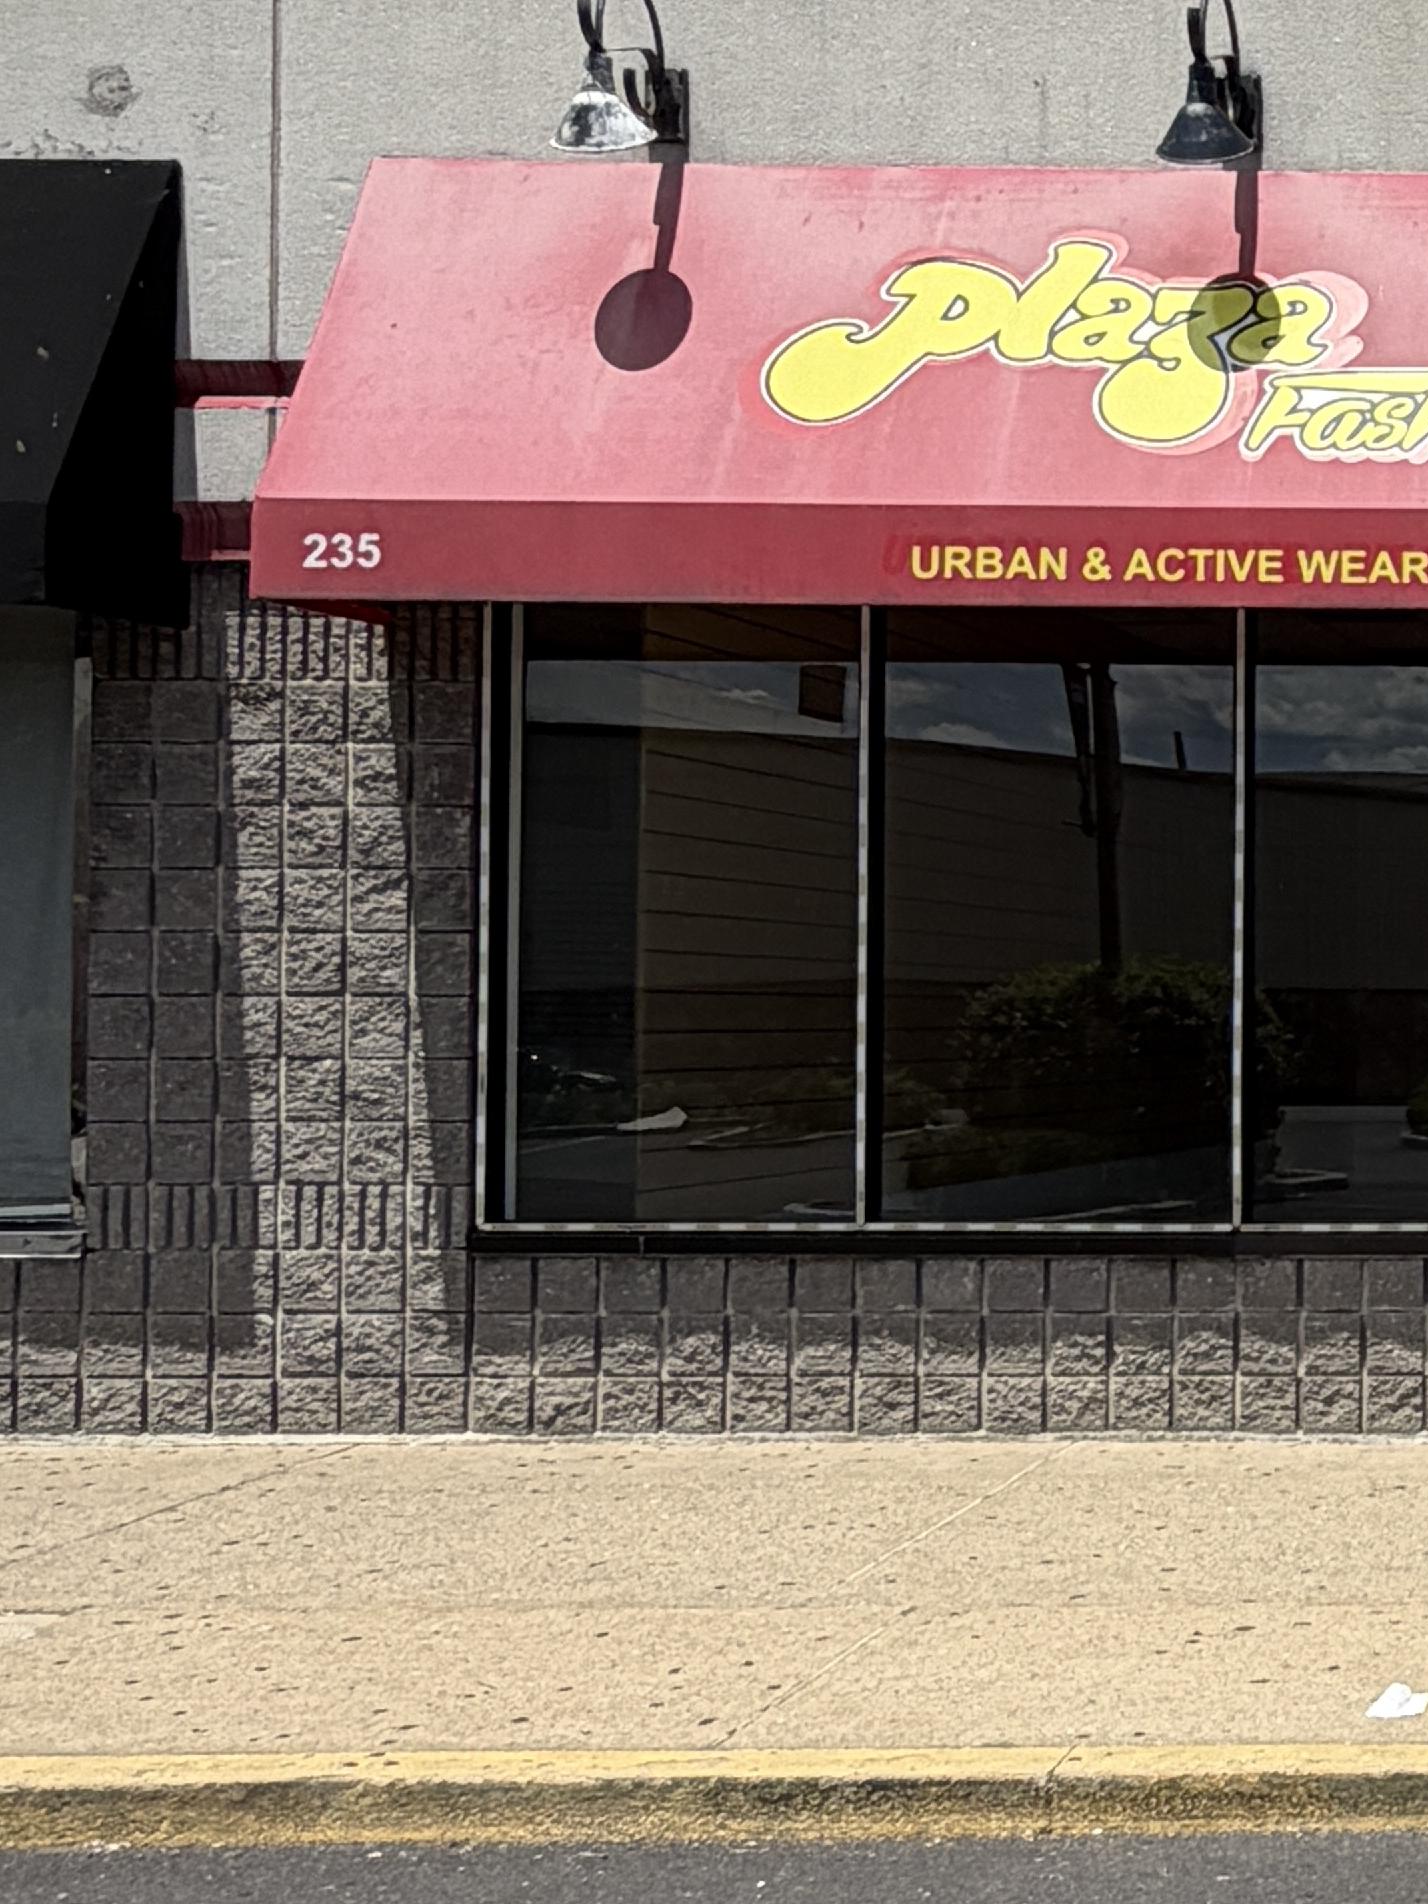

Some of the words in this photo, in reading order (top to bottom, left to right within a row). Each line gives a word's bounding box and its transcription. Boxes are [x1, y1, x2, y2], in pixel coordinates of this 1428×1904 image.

[301, 531, 382, 570] 235
[910, 545, 1069, 582] URBAN
[1081, 546, 1113, 582] &
[1123, 547, 1285, 584] ACTIVE
